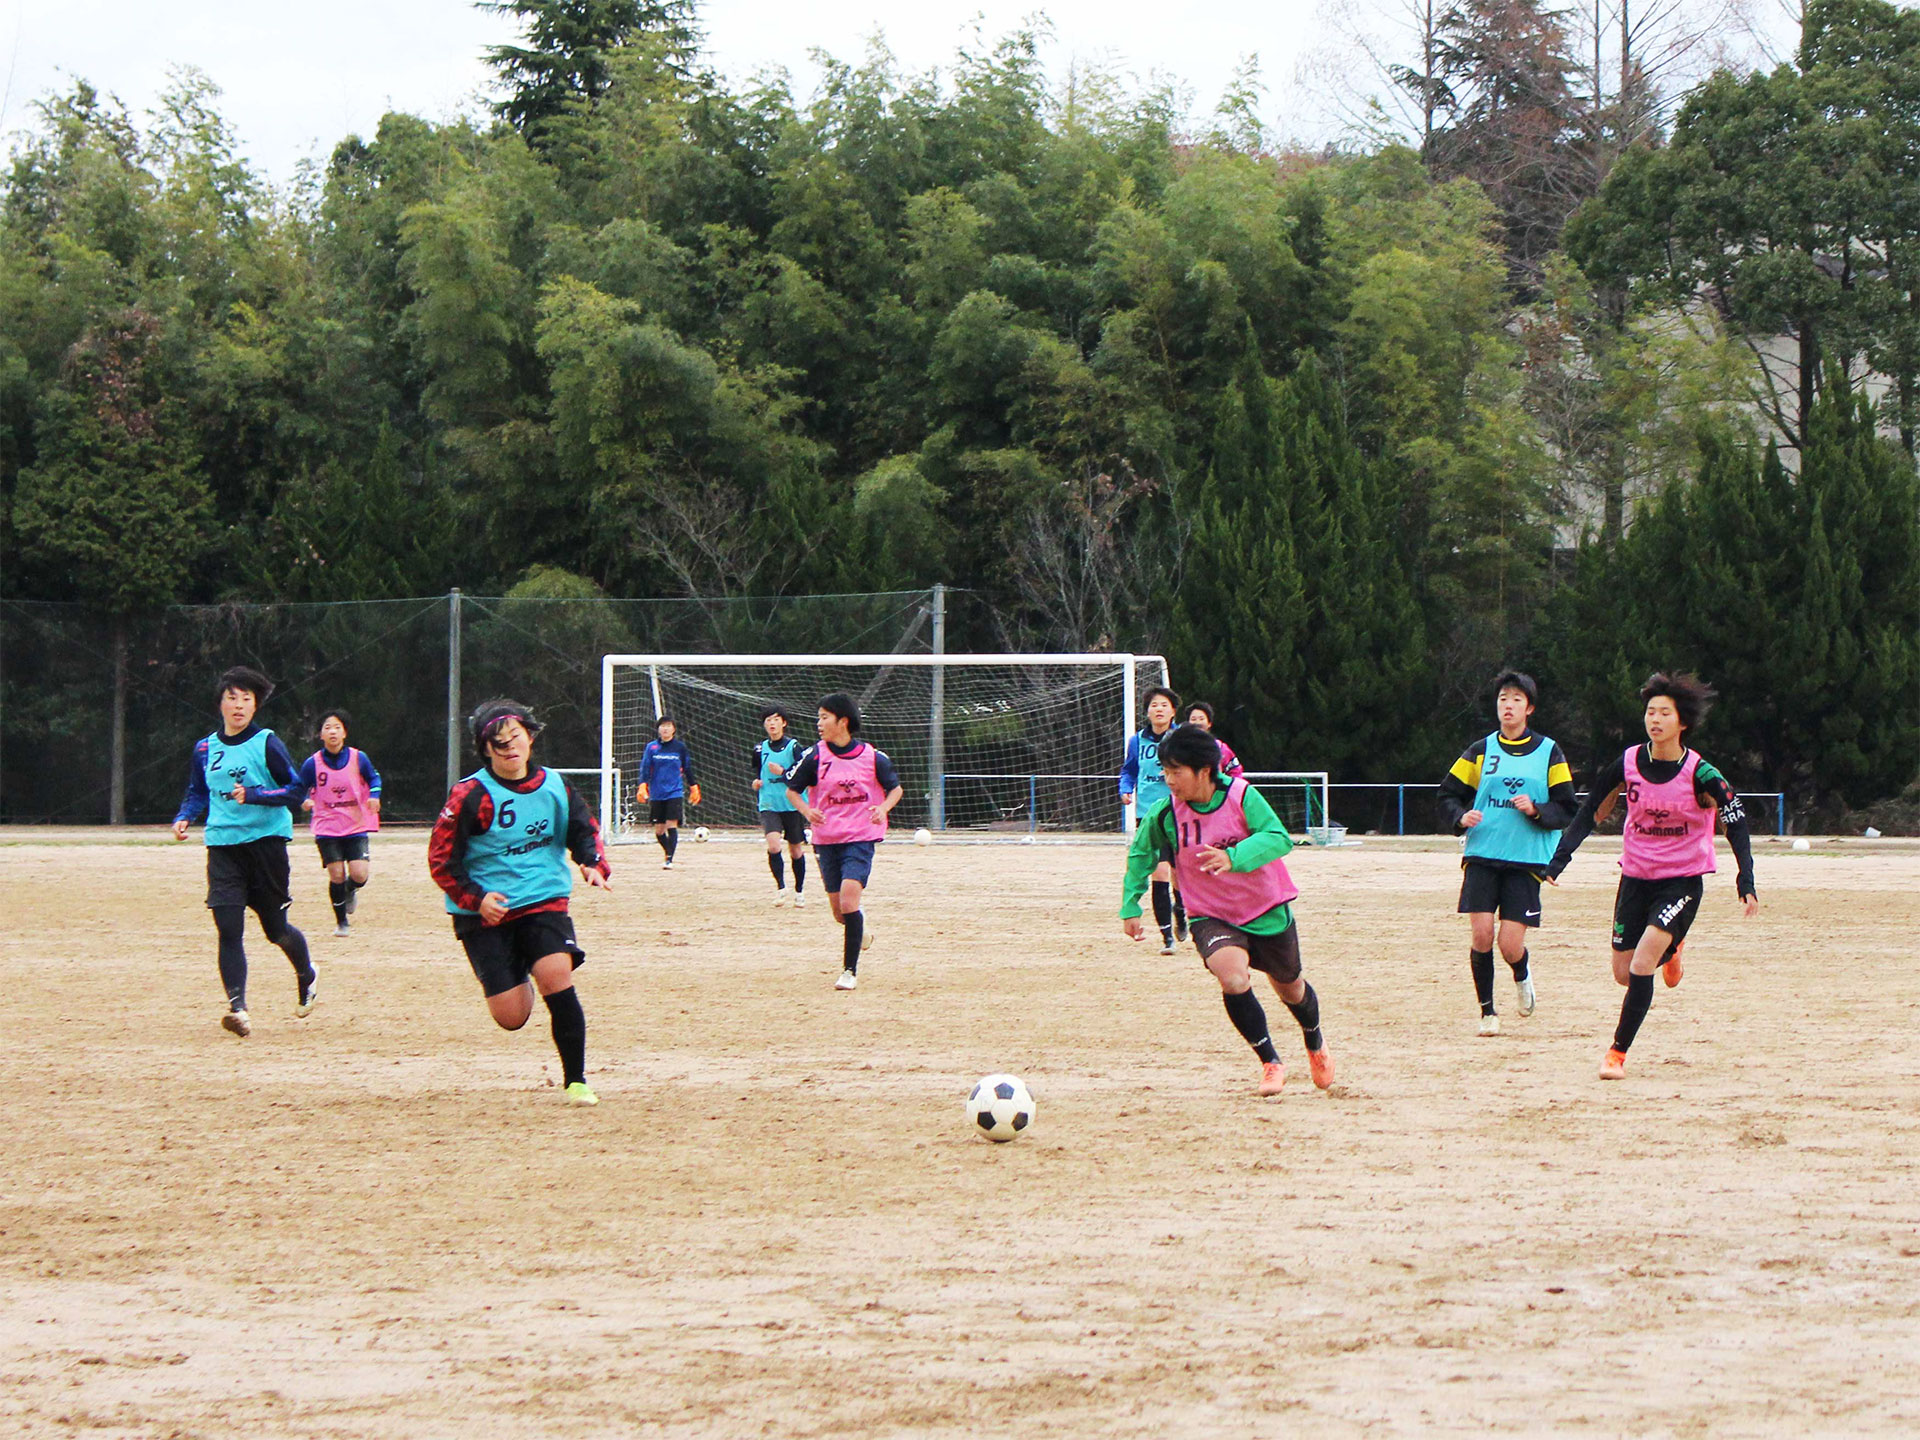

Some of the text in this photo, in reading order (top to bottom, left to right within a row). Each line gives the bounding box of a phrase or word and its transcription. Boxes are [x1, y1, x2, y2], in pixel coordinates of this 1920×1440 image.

[210, 750, 225, 771] 2
[763, 753, 769, 765] 7
[1140, 744, 1157, 760] 10
[821, 761, 832, 780] 7
[1485, 755, 1500, 775] 3
[318, 772, 328, 787] 9
[1628, 782, 1641, 802] 6
[498, 799, 516, 829] 6
[1181, 819, 1202, 848] 11
[1634, 822, 1689, 837] hummel
